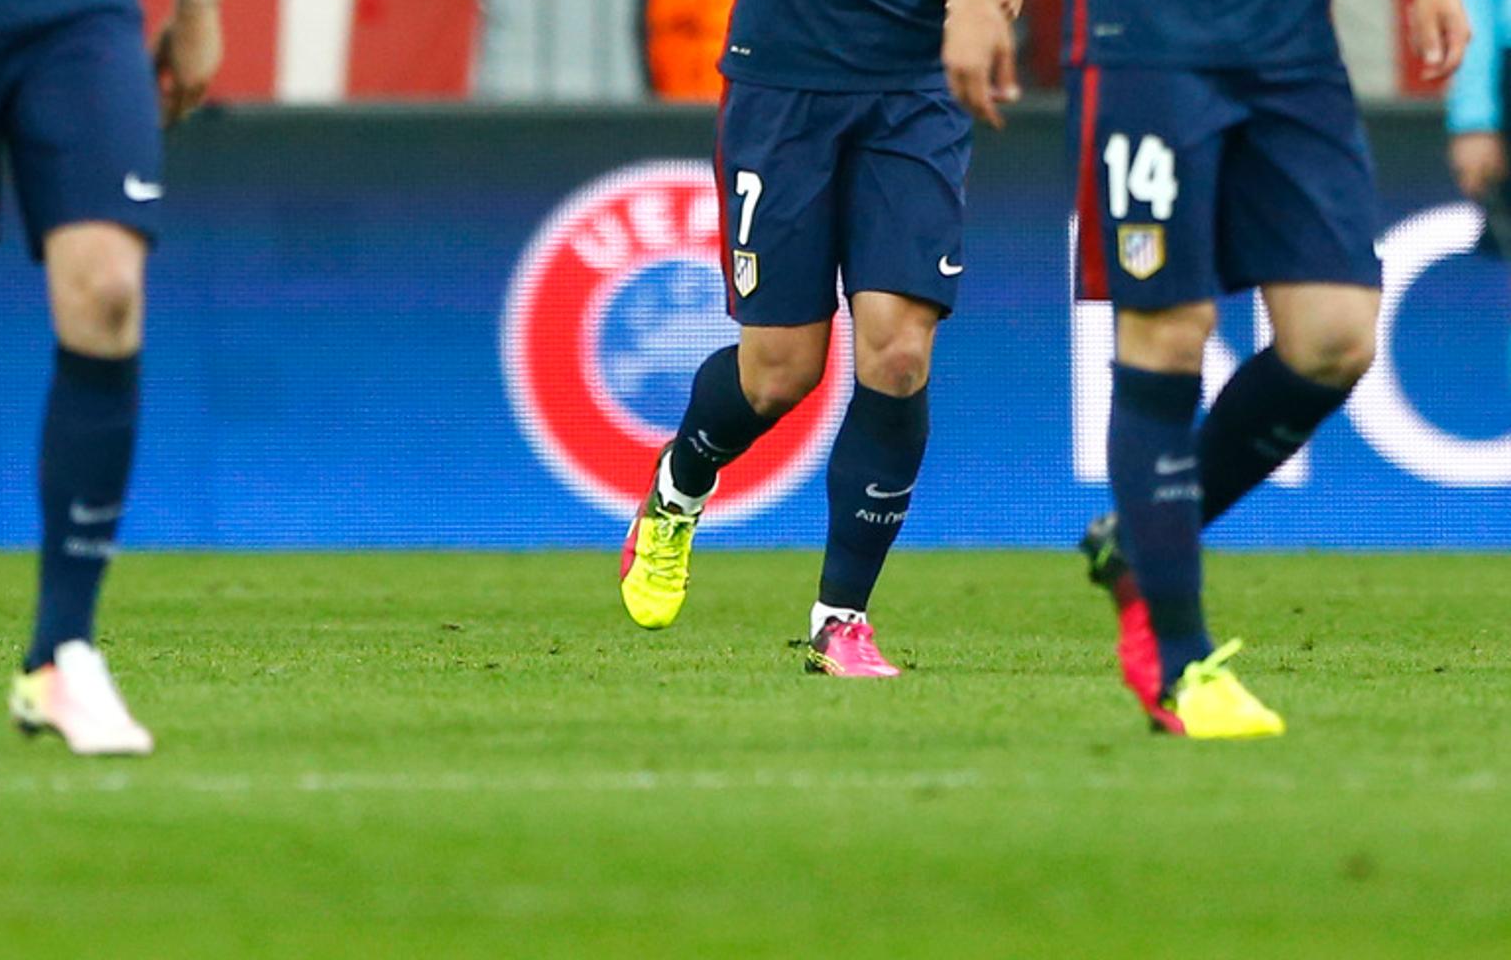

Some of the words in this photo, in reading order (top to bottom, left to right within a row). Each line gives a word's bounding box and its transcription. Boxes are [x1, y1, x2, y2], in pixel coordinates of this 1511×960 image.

[735, 170, 763, 245] 7
[1103, 132, 1179, 221] 14
[569, 193, 722, 269] UEF
